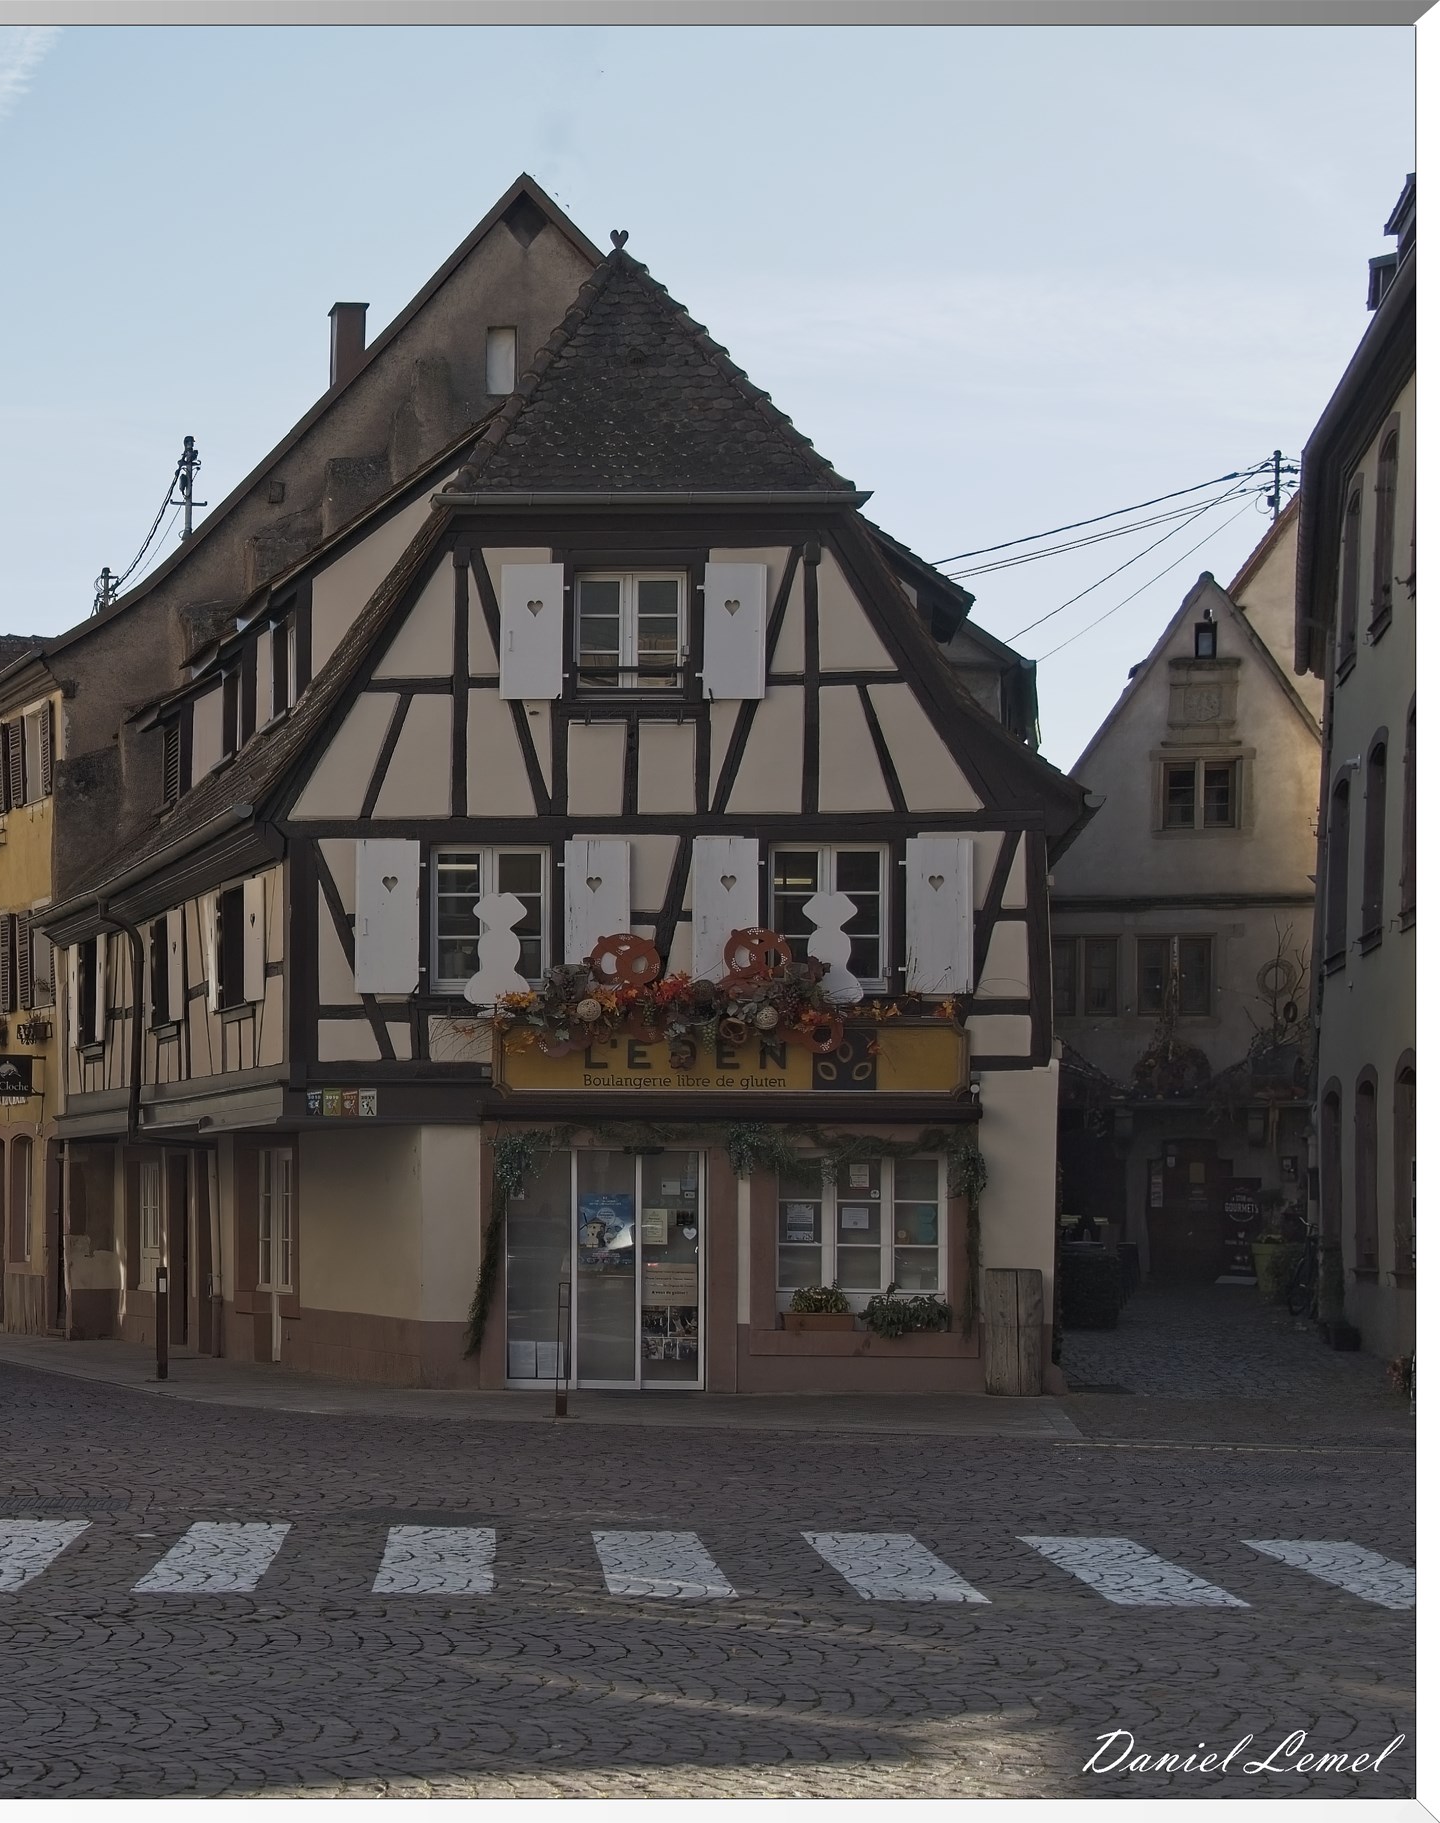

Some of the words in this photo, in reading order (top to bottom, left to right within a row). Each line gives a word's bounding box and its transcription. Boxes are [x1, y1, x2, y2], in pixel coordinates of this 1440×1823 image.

[583, 1074, 671, 1091] Boulangerie
[677, 1074, 711, 1088] libre
[716, 1074, 735, 1088] de
[740, 1075, 786, 1091] gluten
